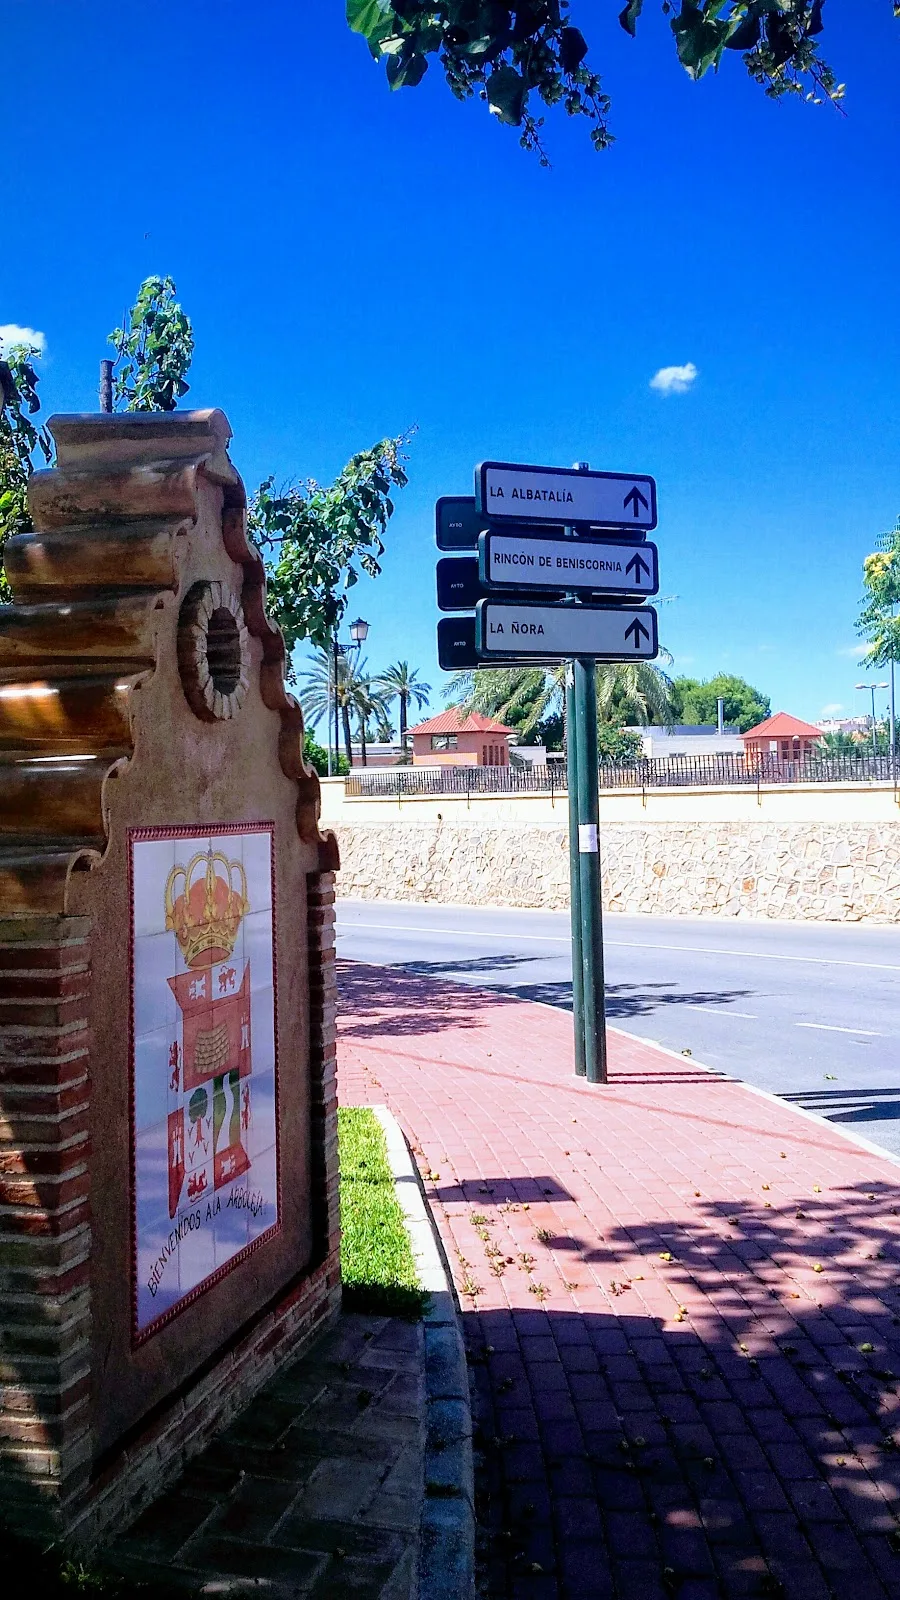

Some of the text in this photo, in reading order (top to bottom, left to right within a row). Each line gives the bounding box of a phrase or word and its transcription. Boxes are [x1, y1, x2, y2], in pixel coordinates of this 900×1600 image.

[490, 486, 574, 503] LA ALBATALÍA
[493, 551, 622, 572] RINCÓN DE BENISCORNIA
[490, 621, 545, 635] LA ÑORA
[147, 1210, 201, 1298] BIENVENIDOS
[205, 1202, 212, 1222] A
[212, 1196, 221, 1217] LA
